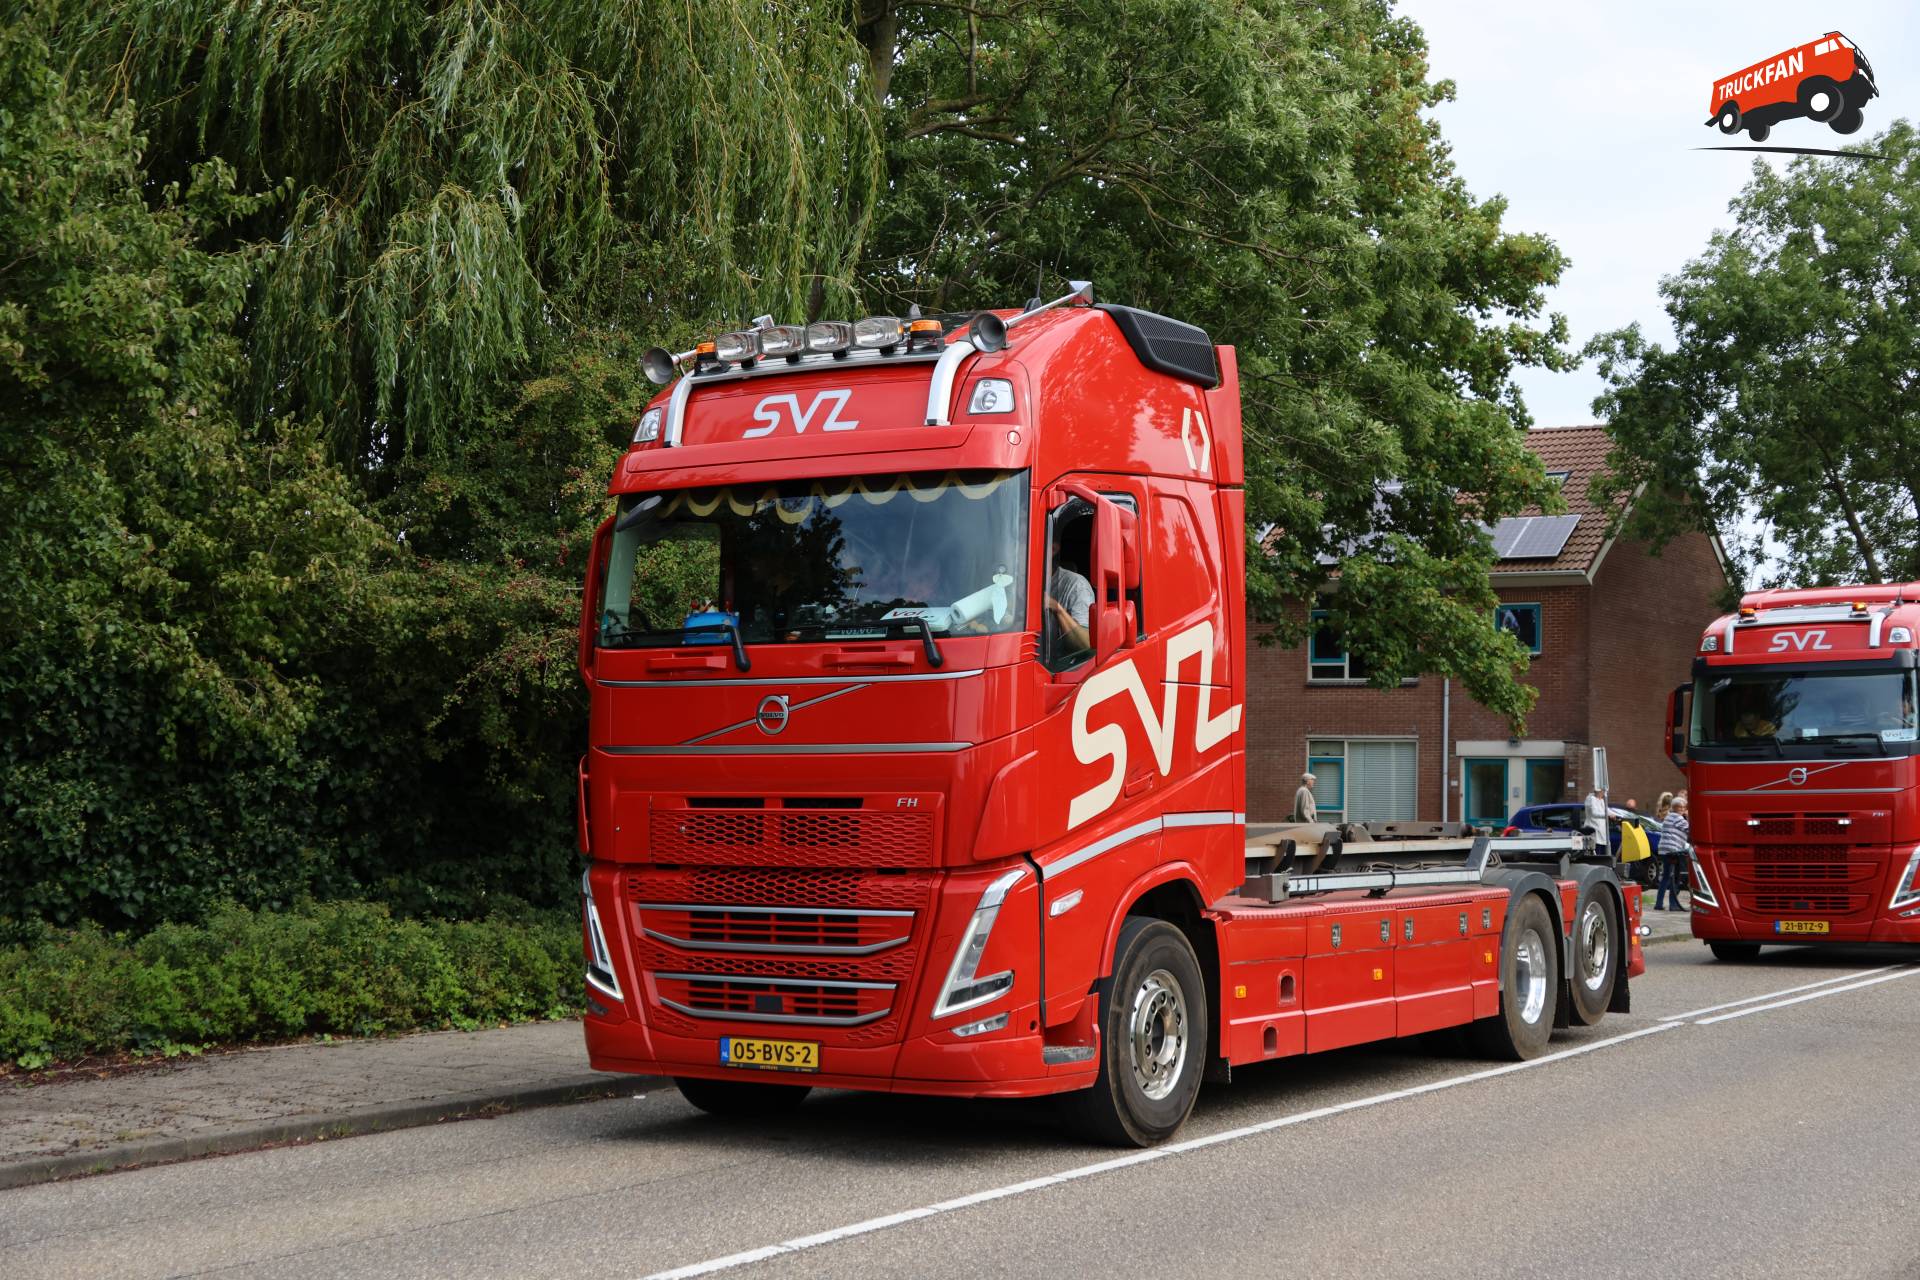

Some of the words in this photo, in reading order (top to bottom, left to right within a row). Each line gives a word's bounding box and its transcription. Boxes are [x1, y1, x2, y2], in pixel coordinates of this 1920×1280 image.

[742, 389, 860, 439] SVZ
[1767, 630, 1833, 653] SVZ
[1067, 620, 1243, 831] SVZ
[896, 797, 919, 808] FH
[1784, 922, 1824, 931] 21-BTZ-9
[733, 1041, 812, 1064] 05-BVS-2
